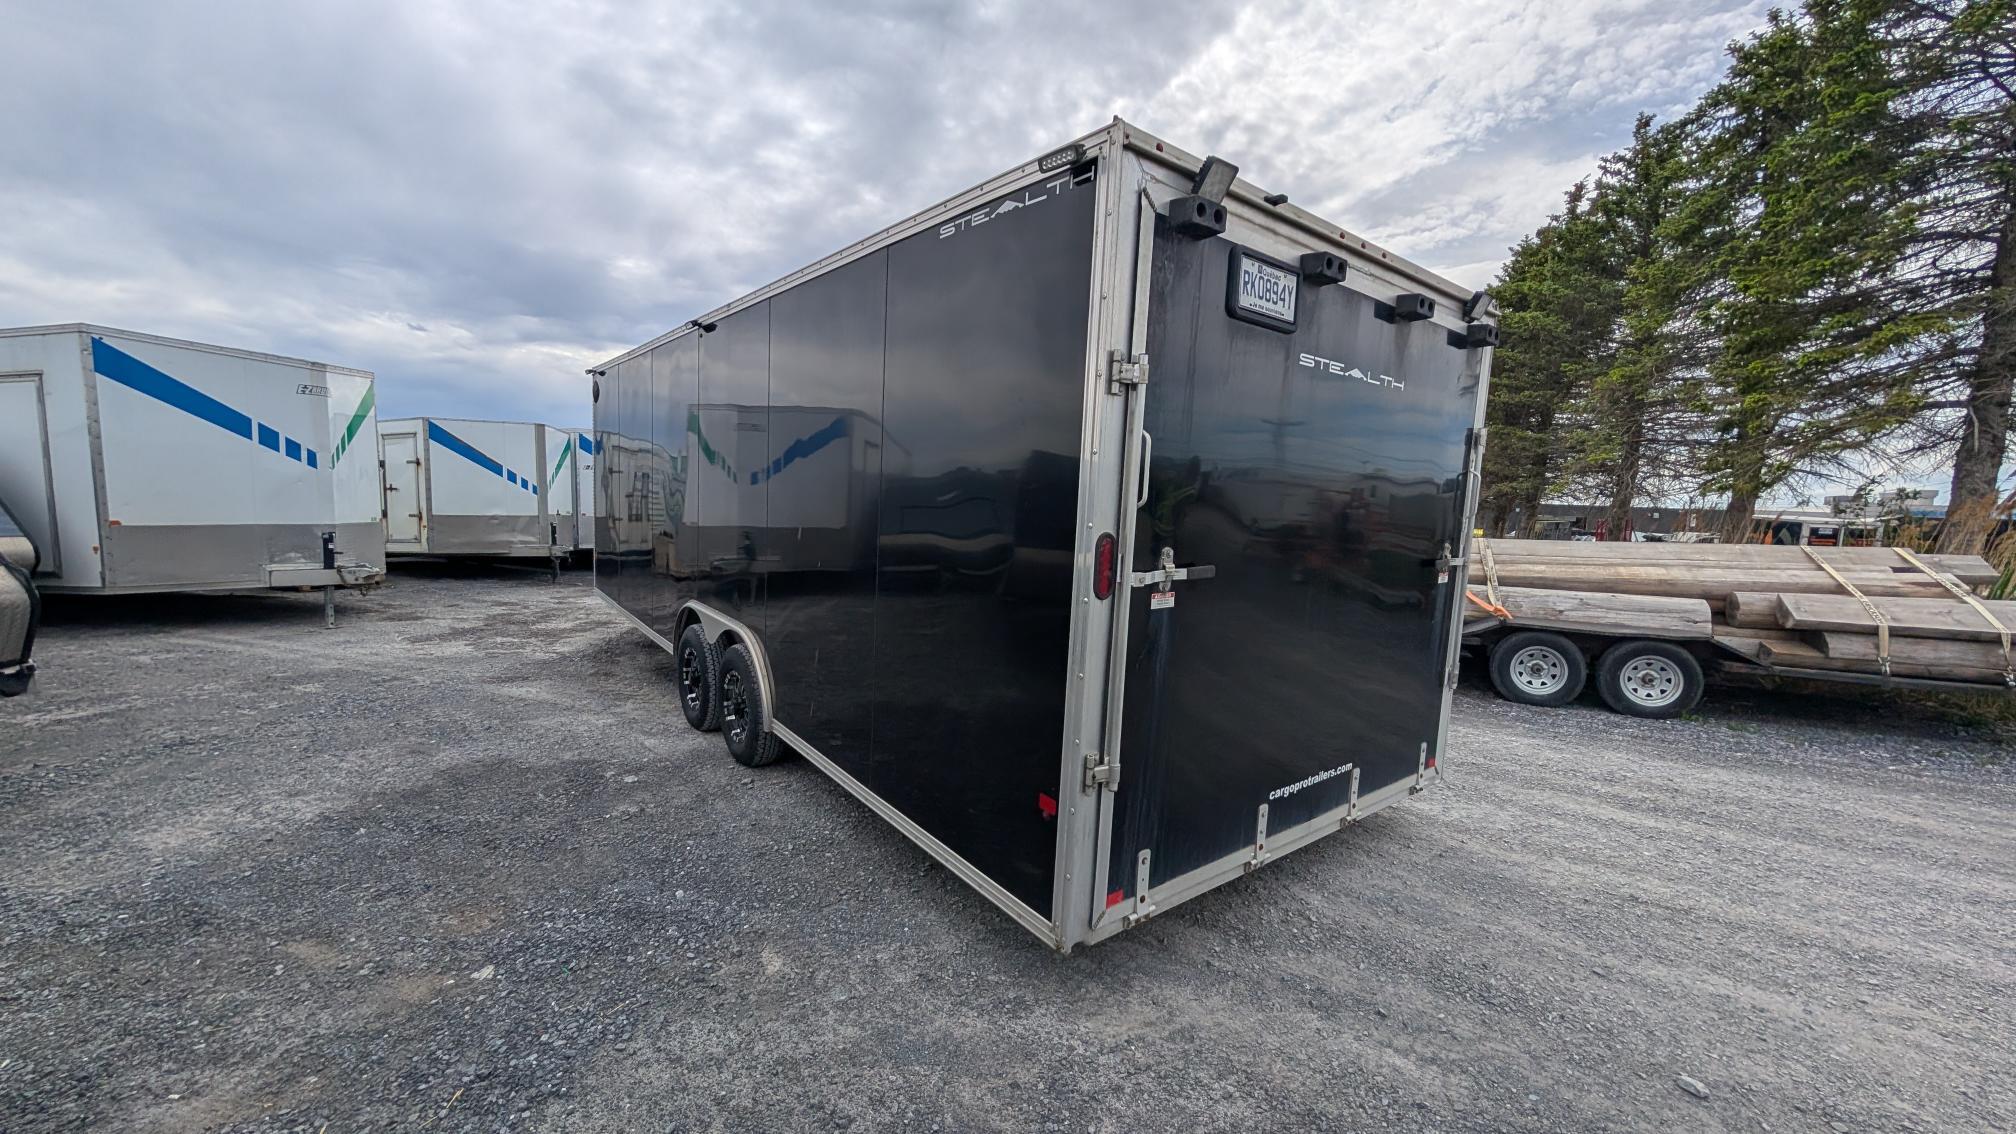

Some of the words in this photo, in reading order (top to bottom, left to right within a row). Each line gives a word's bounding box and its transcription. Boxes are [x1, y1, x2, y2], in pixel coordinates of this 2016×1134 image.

[940, 165, 1095, 239] STEALTH
[1299, 353, 1404, 391] STEALTH
[1269, 762, 1353, 800] cargoprotrailers.com
